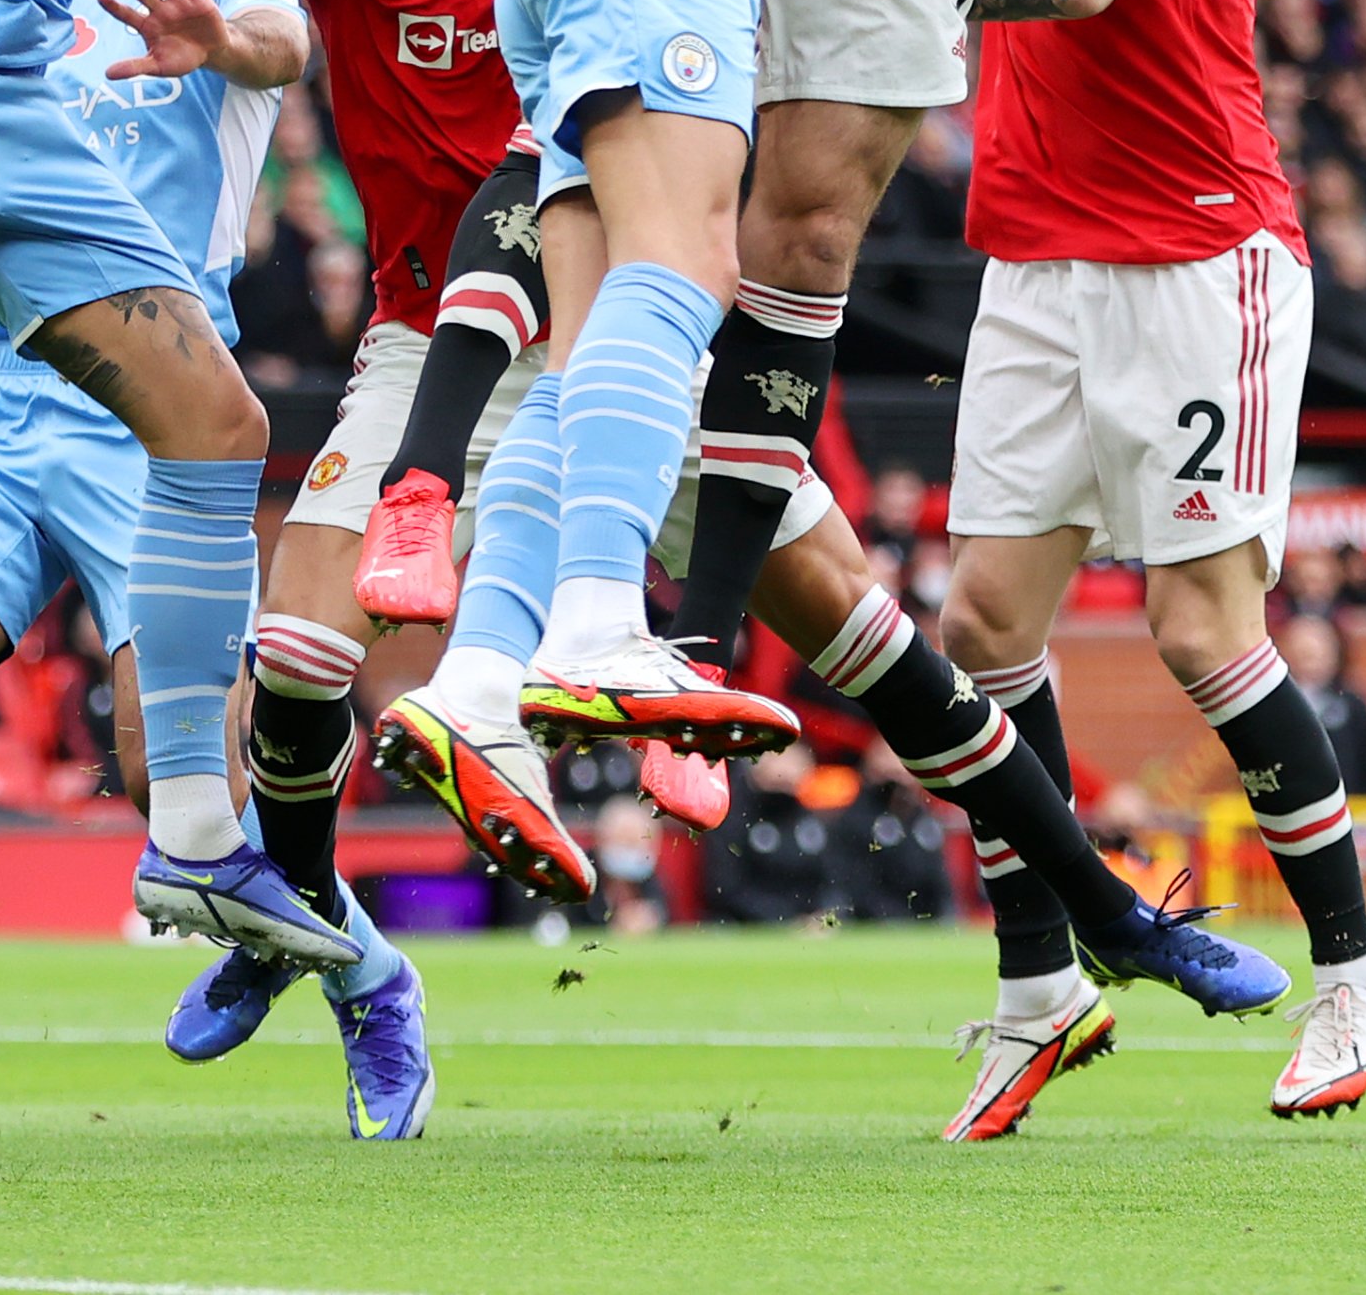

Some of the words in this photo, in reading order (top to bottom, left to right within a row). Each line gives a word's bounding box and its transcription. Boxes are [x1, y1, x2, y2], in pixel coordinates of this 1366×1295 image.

[456, 28, 498, 54] Tea
[61, 74, 183, 120] HAD
[86, 121, 141, 151] AYS
[1173, 399, 1226, 483] 2
[1172, 509, 1218, 522] adidas
